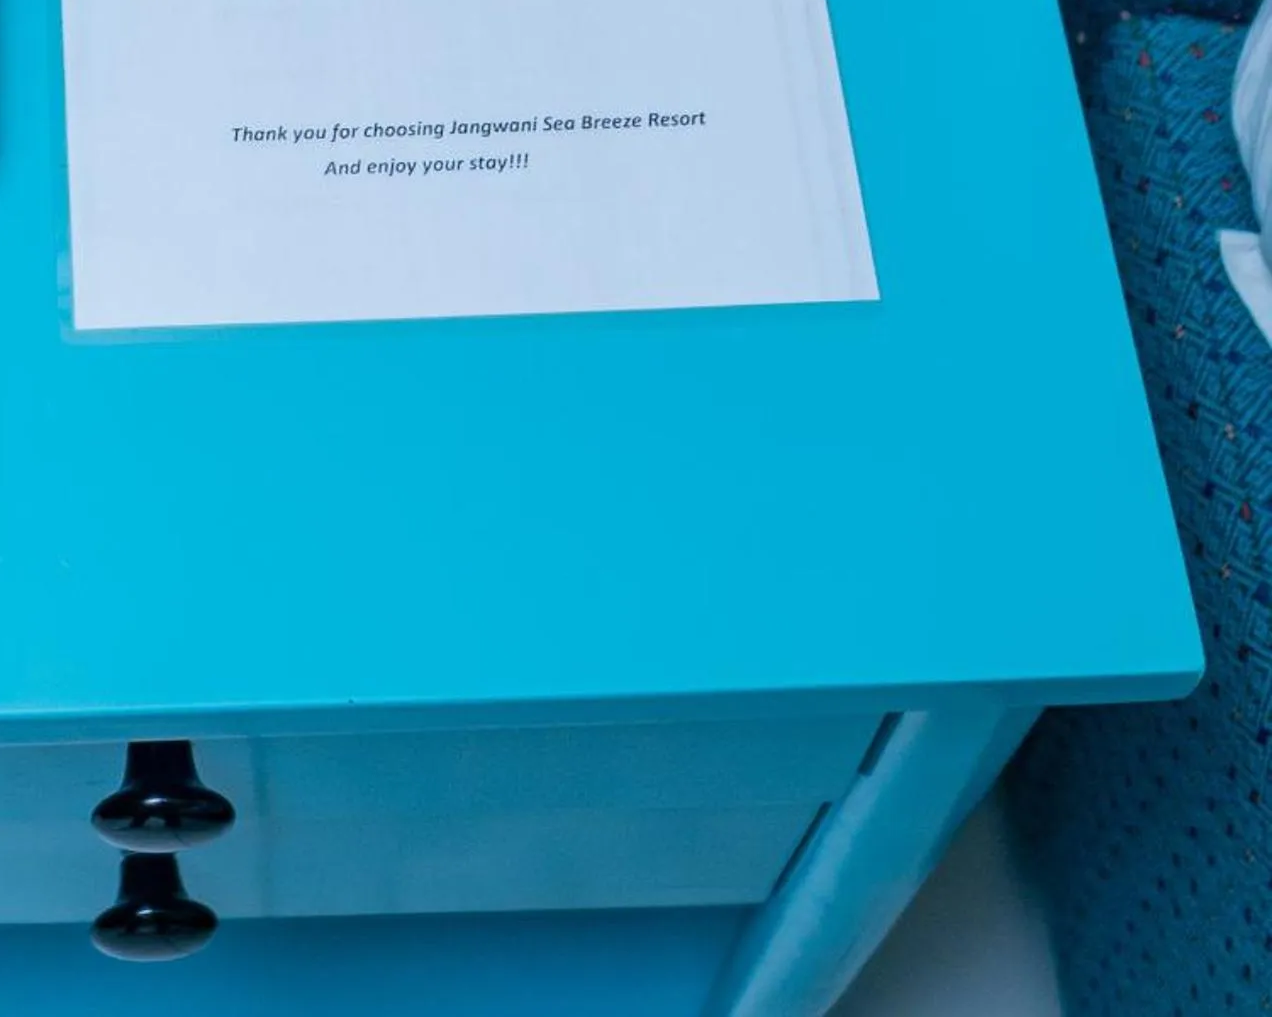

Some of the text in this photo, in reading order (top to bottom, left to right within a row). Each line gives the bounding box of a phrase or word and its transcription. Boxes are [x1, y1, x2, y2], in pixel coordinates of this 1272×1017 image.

[233, 111, 706, 144] Thank you for choosing Jangwani Sea Breeze Resort
[324, 153, 529, 177] And enjoy your stay!!!
